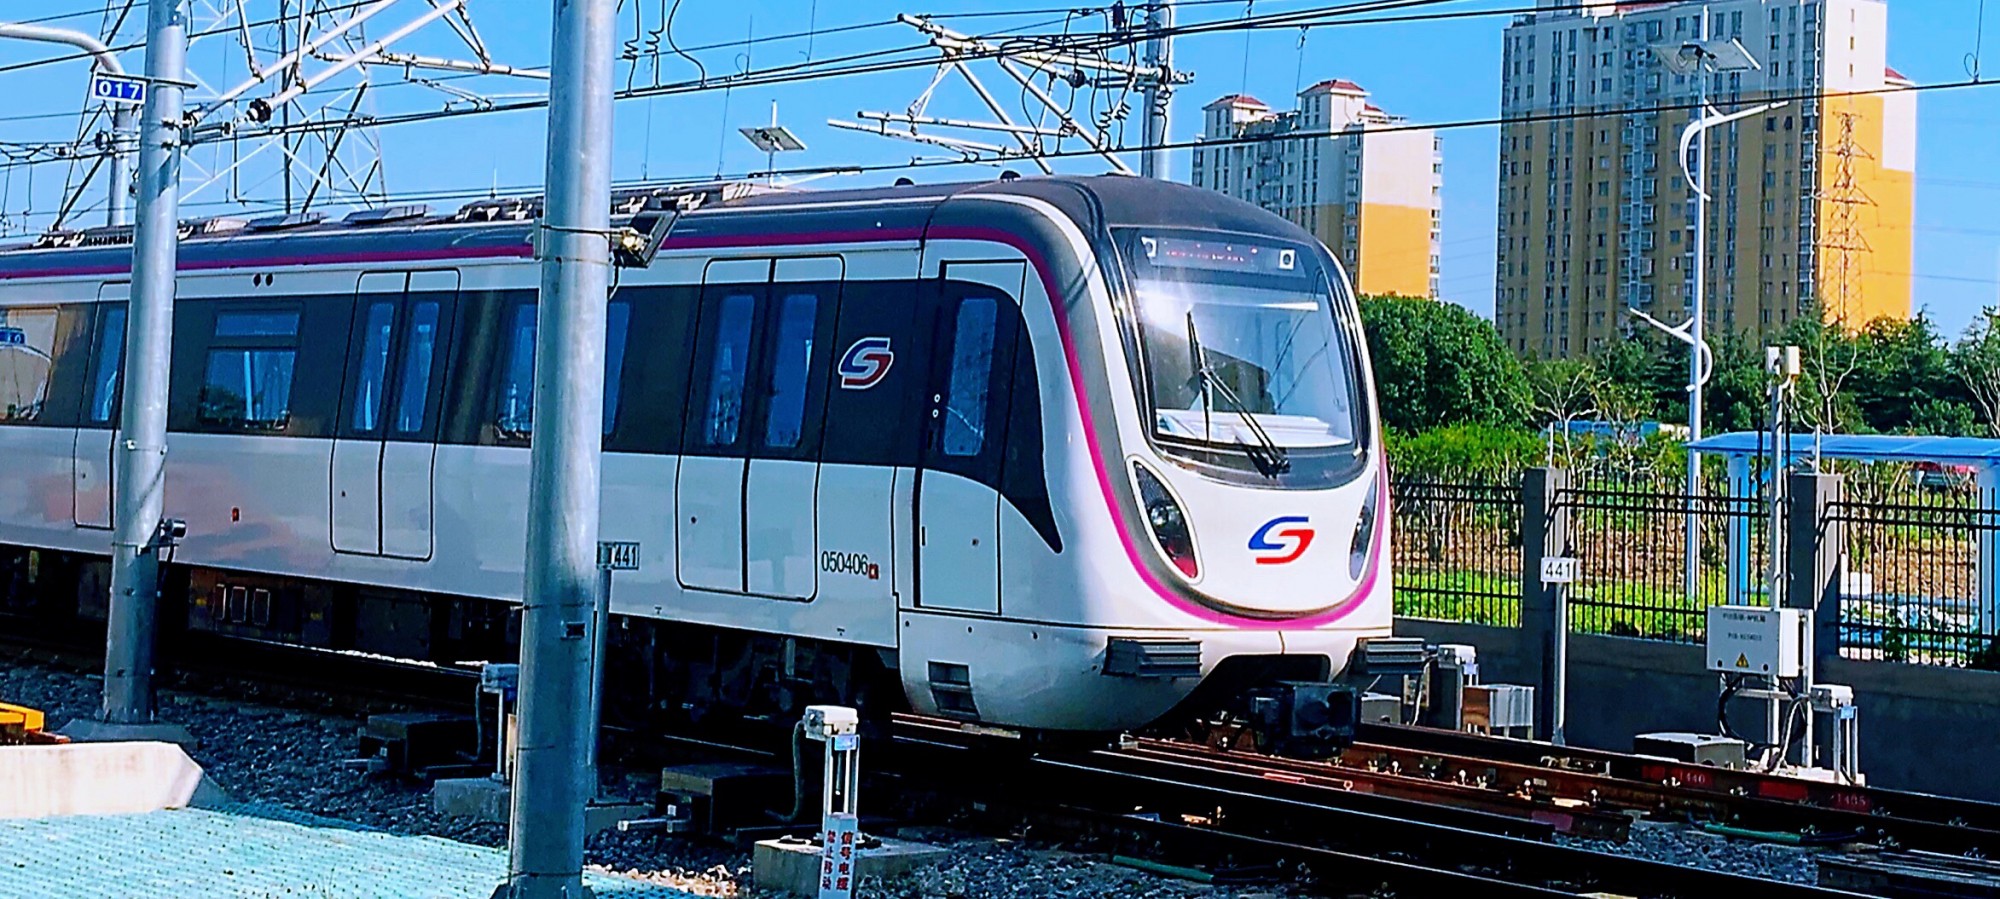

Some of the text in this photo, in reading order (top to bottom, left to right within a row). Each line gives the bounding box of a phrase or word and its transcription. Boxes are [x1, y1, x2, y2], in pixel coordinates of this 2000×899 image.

[98, 81, 140, 99] 017
[614, 544, 636, 566] 441
[821, 550, 868, 575] 050406
[1546, 561, 1570, 577] 441
